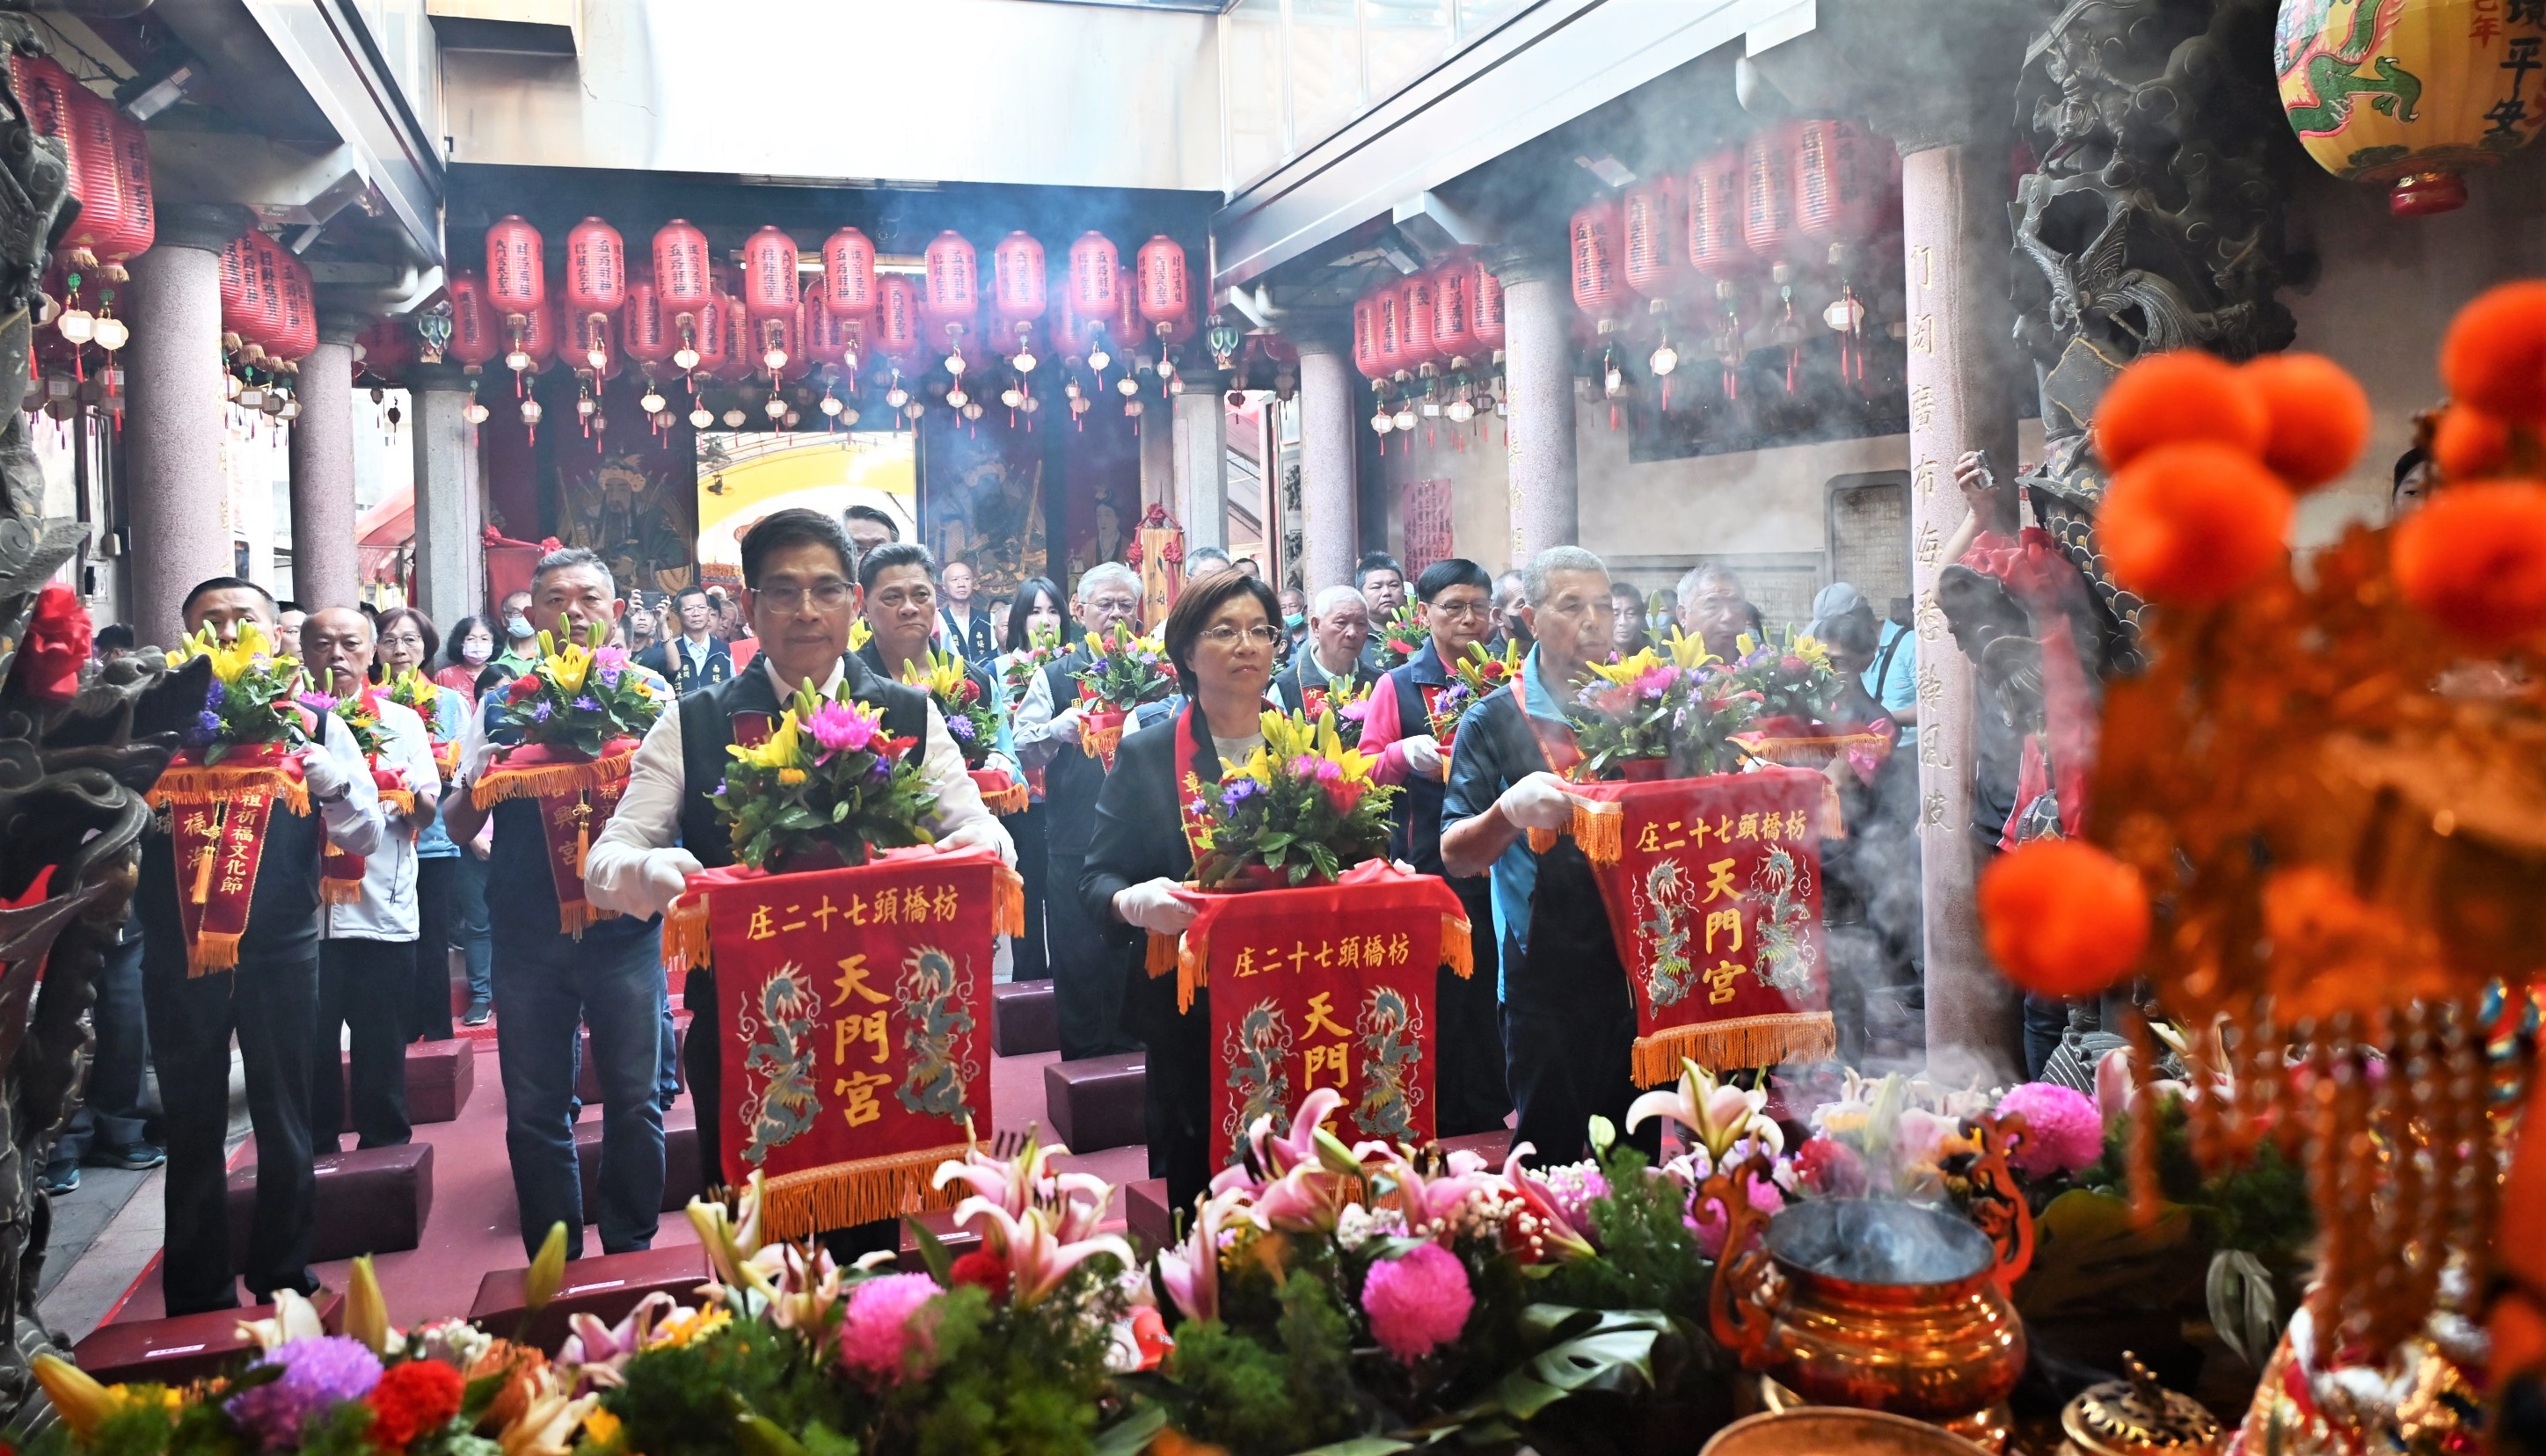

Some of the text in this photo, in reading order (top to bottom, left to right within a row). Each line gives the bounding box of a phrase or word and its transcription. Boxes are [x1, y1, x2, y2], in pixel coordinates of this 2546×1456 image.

[1701, 857, 1747, 1006] 天門宮
[828, 953, 893, 1128] 天門宮
